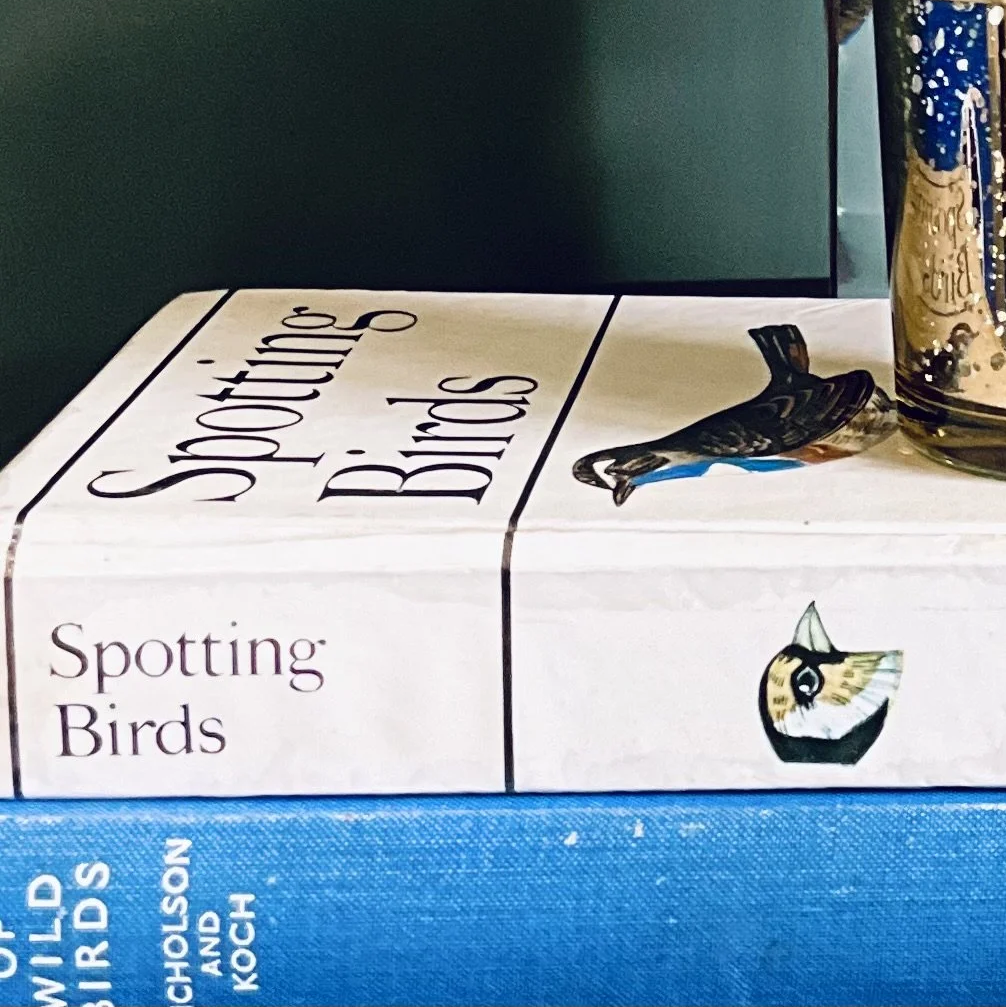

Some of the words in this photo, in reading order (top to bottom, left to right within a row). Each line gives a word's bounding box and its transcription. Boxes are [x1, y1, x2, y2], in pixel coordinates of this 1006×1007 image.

[88, 307, 418, 502] Spotting
[317, 375, 538, 505] Birds
[49, 621, 327, 694] Spotting
[55, 703, 227, 757] Birds
[28, 874, 67, 1007] WILD
[199, 911, 223, 976] AND
[229, 894, 260, 991] KOCH
